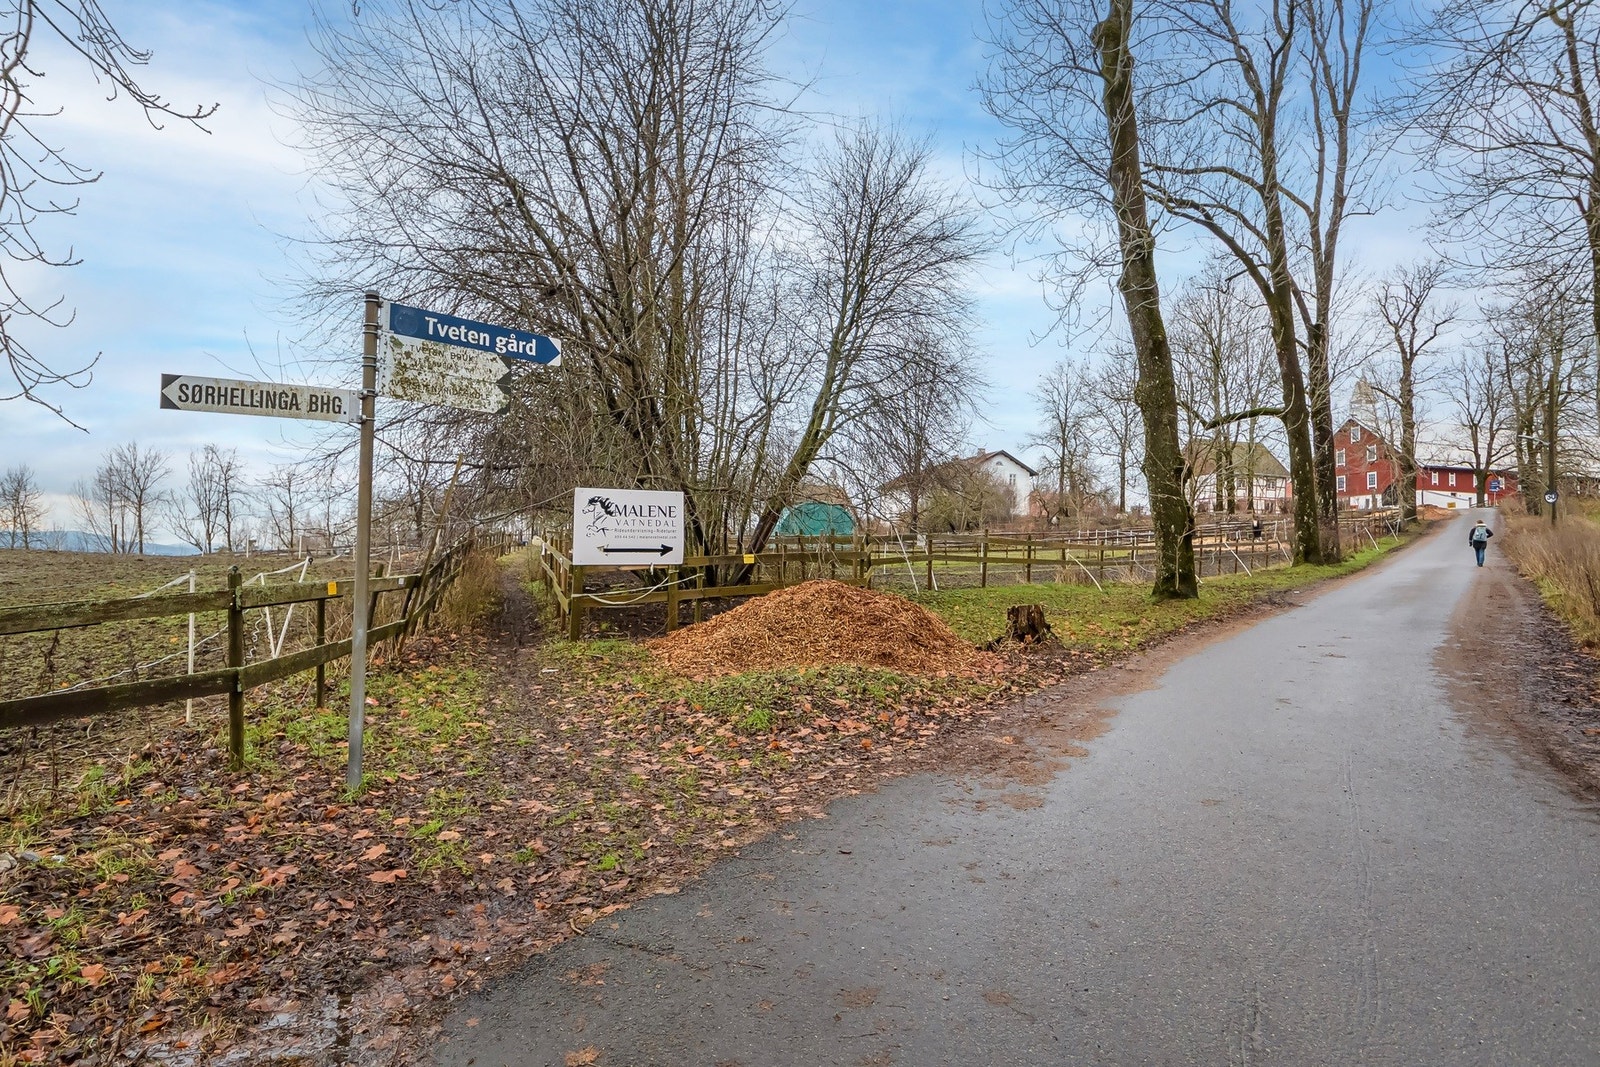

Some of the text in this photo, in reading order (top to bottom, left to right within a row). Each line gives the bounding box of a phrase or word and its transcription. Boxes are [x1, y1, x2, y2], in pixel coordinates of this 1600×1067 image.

[425, 316, 536, 356] Tveten gård
[178, 383, 347, 415] SØRHELLINGA BHG.
[614, 504, 677, 518] MALENE
[615, 518, 677, 527] VATNEDAL
